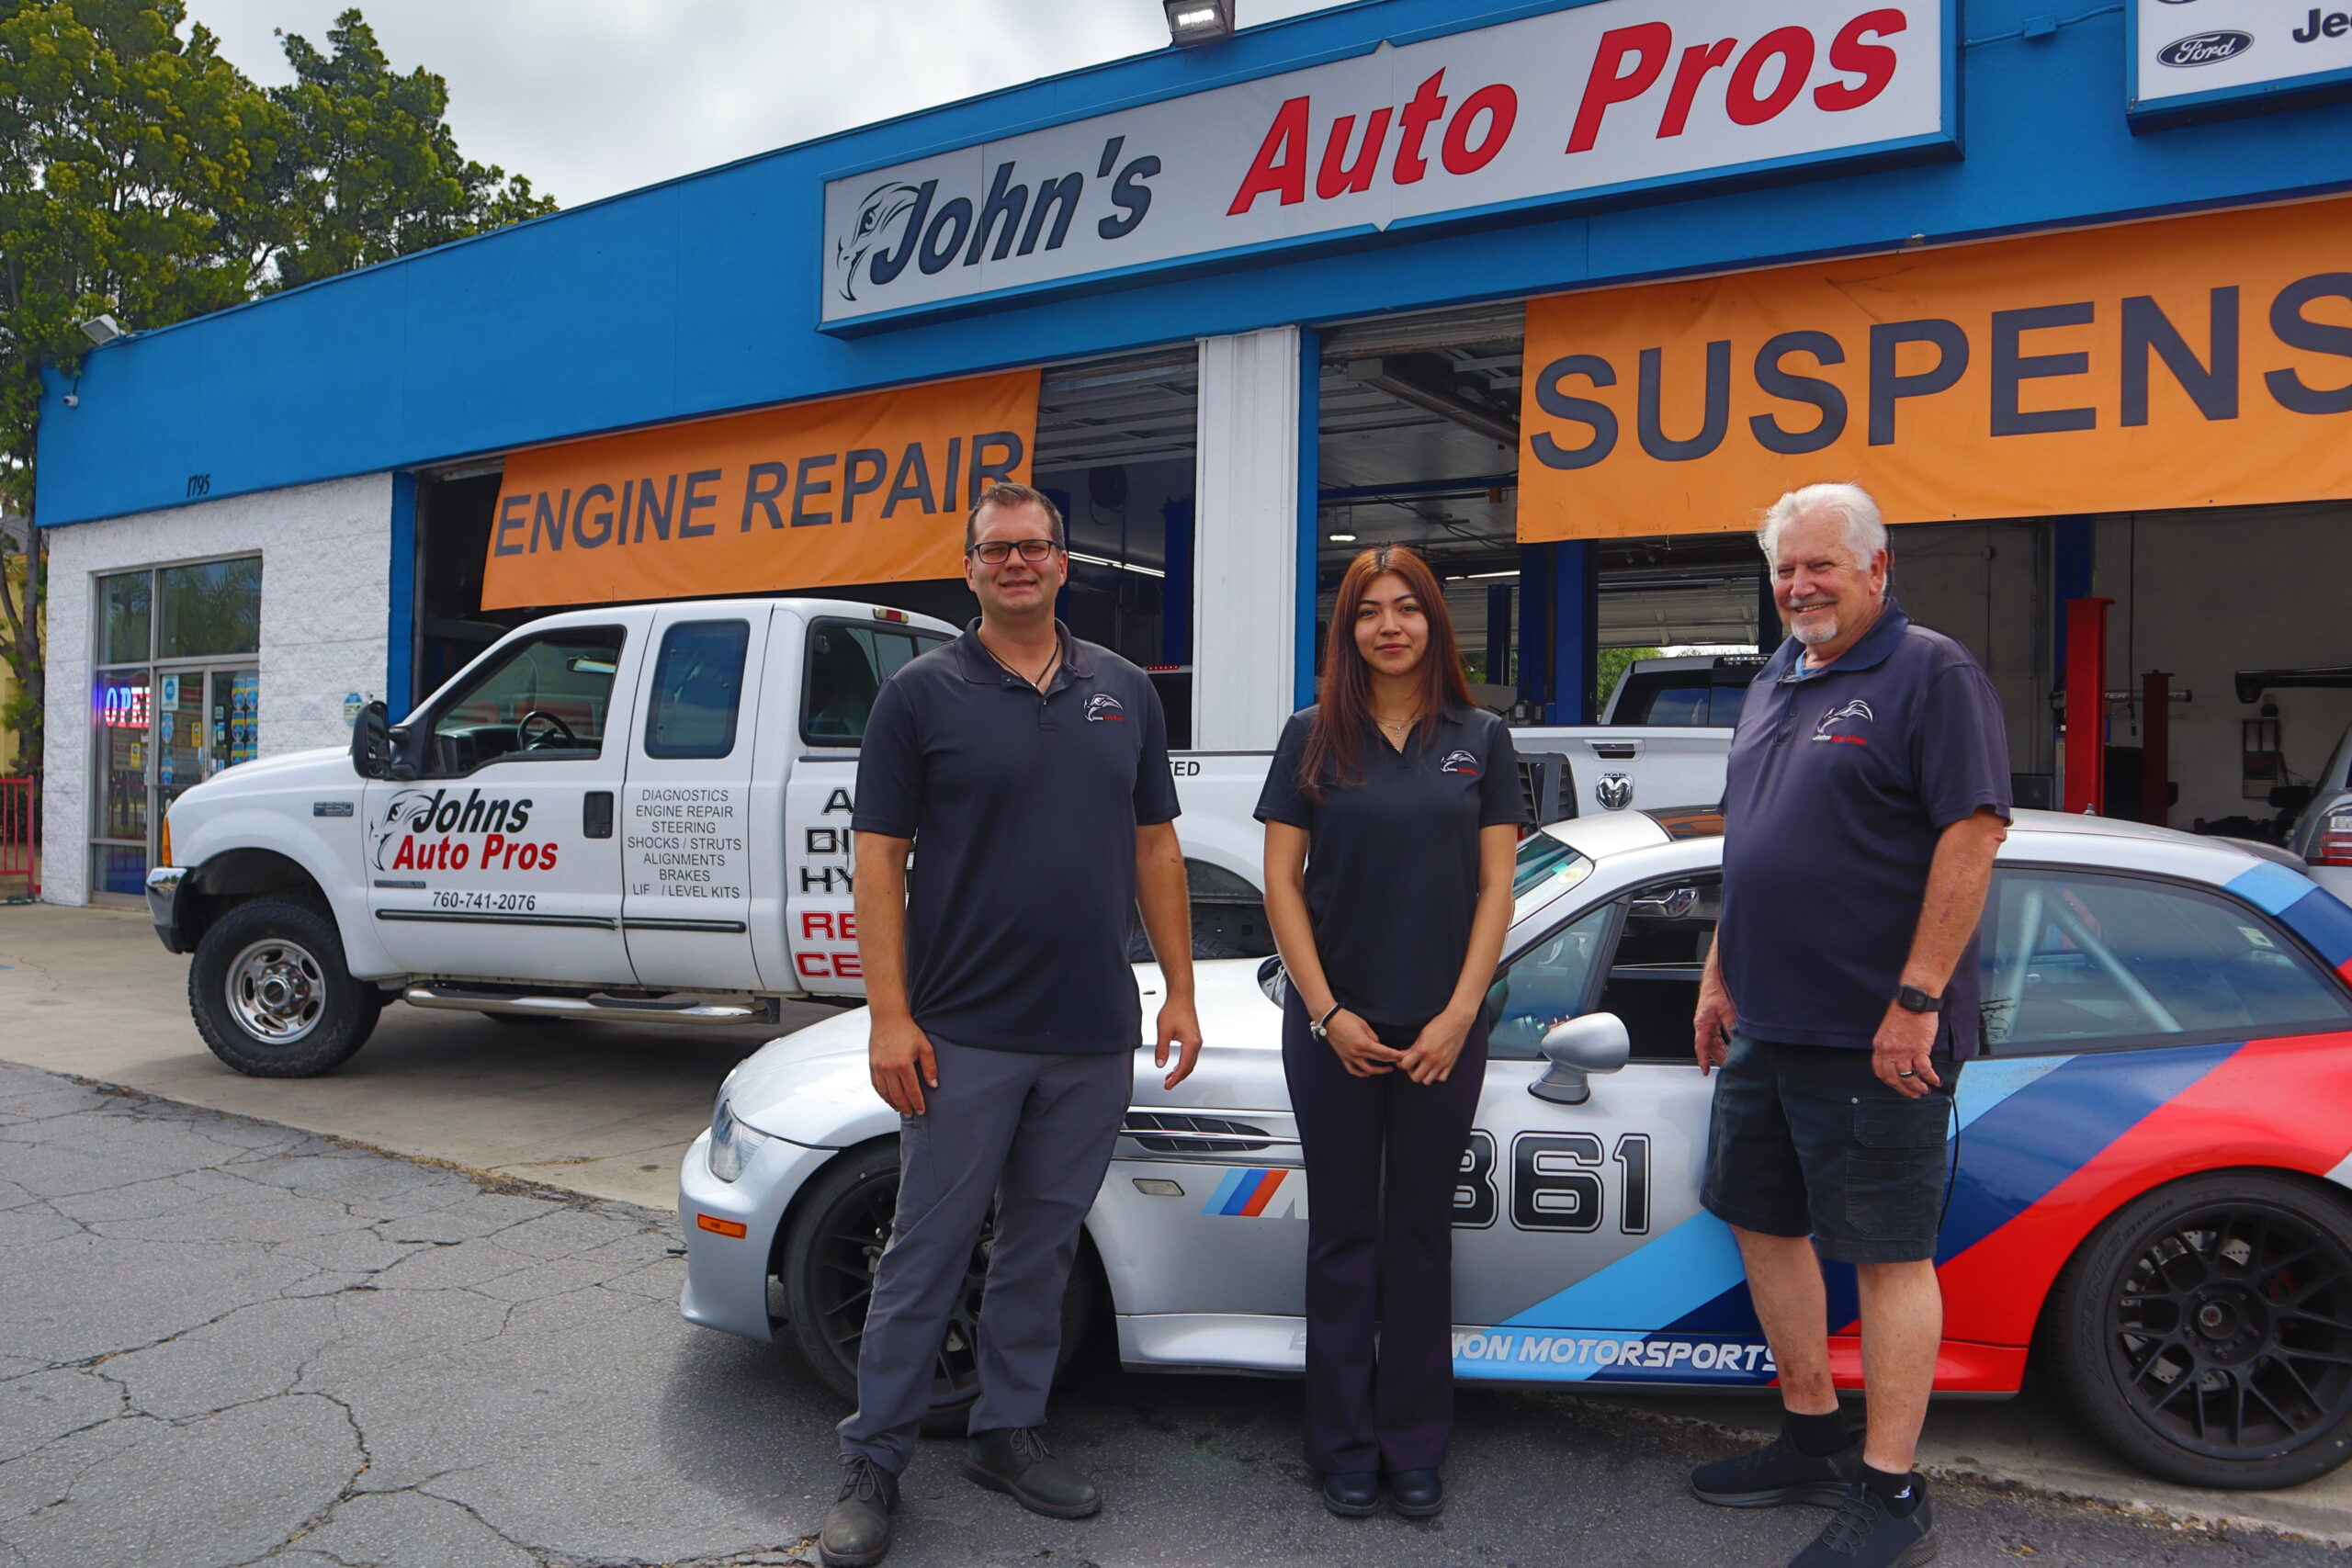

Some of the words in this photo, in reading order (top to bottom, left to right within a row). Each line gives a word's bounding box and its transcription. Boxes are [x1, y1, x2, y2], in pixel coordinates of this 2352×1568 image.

[2292, 7, 2352, 43] Je
[868, 135, 1161, 286] John's
[1227, 65, 1519, 217] Auto
[1565, 7, 1908, 154] Pros
[1529, 270, 2352, 471] SUSPENS
[187, 473, 211, 497] 1795
[493, 468, 722, 558] ENGINE
[740, 430, 1023, 534] REPAIR
[1170, 761, 1202, 777] ED
[641, 788, 729, 803] DIAGNOSTICS
[412, 787, 534, 834] Johns
[635, 804, 684, 818] ENGINE
[686, 805, 734, 818] REPAIR
[651, 820, 717, 834] STEERING
[391, 834, 470, 872] Auto
[480, 833, 560, 872] Pros
[627, 836, 680, 850] SHOCKS
[690, 837, 742, 852] STRUTS
[643, 852, 726, 867] ALIGNMENTS
[659, 868, 711, 883] BRAKES
[668, 884, 708, 898] LEVEL
[711, 886, 741, 899] KITS
[432, 891, 537, 912] 760-741-2076
